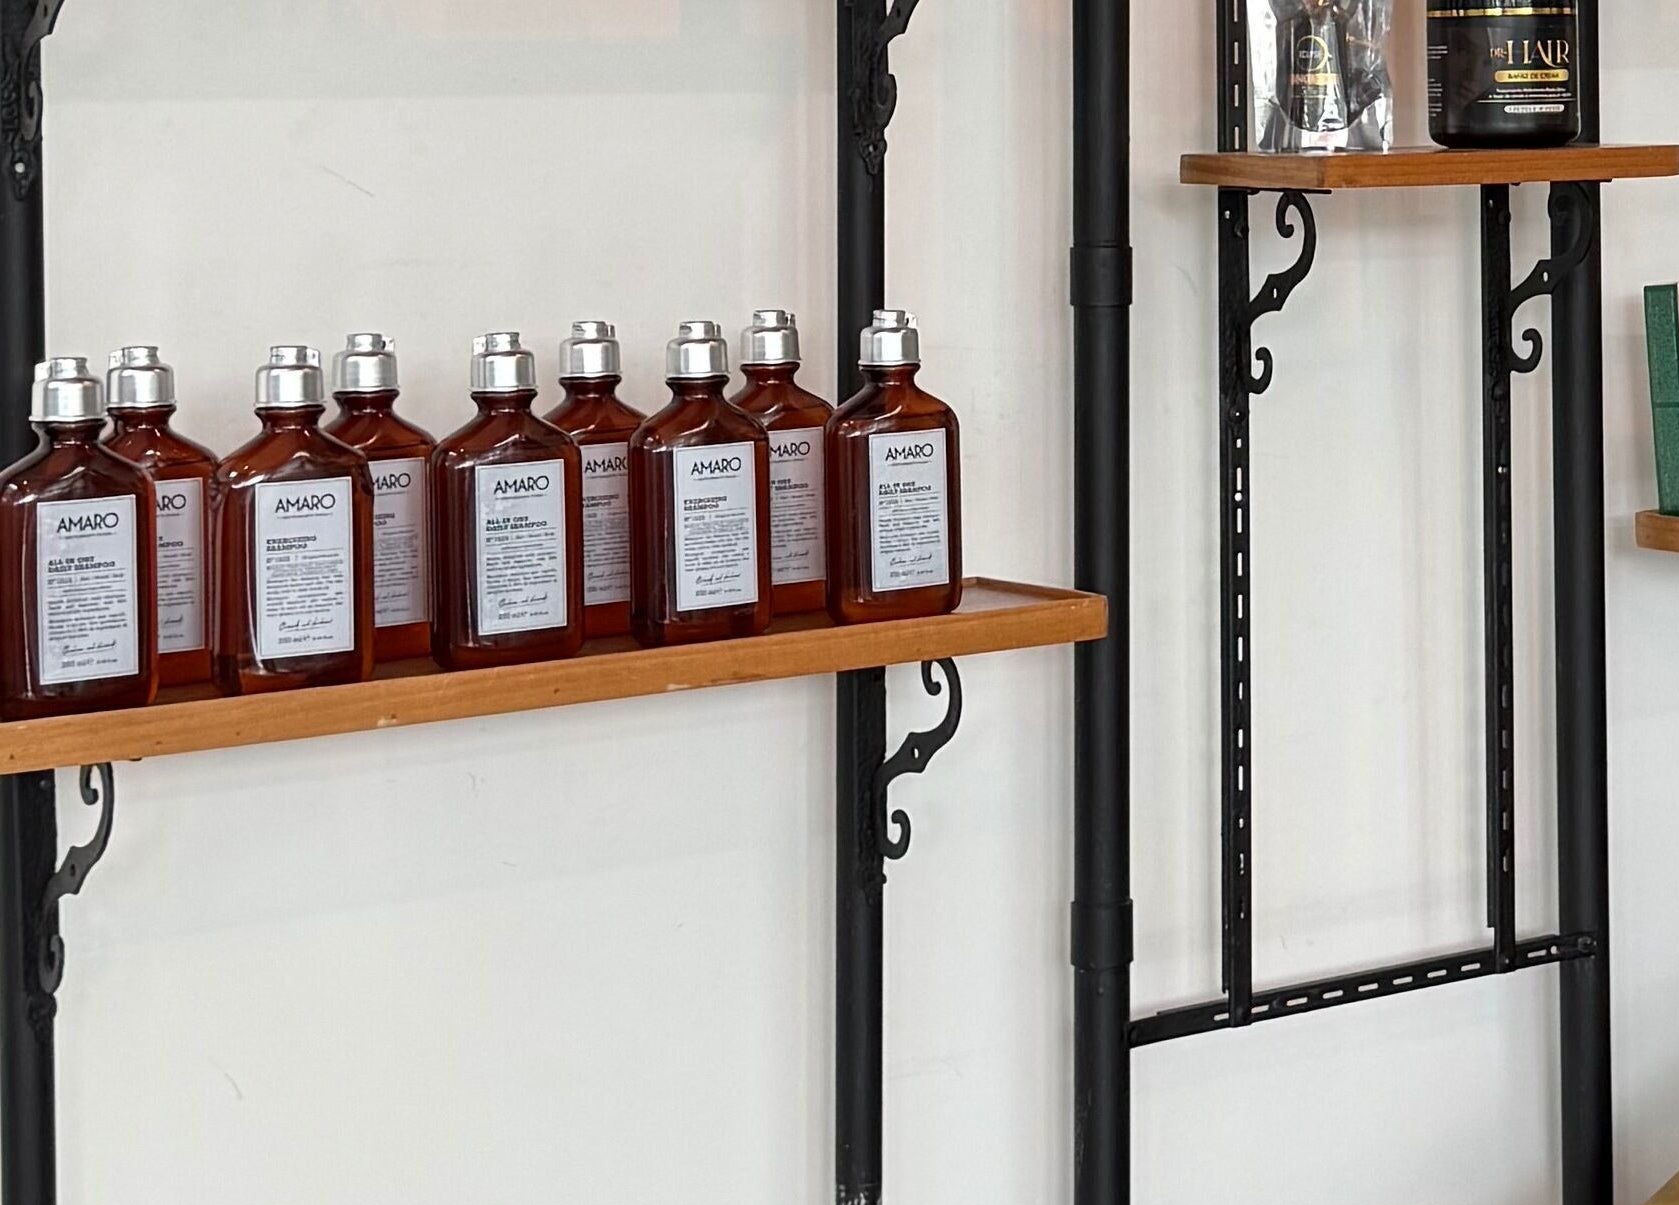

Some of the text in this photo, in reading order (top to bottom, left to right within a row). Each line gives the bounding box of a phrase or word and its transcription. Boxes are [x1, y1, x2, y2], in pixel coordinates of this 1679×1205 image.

[770, 441, 810, 457] MARO
[885, 443, 934, 461] AMARO
[691, 457, 742, 475] AMARO
[493, 475, 550, 495] AMARO
[275, 493, 336, 513] AMARO
[57, 512, 119, 533] AMARO
